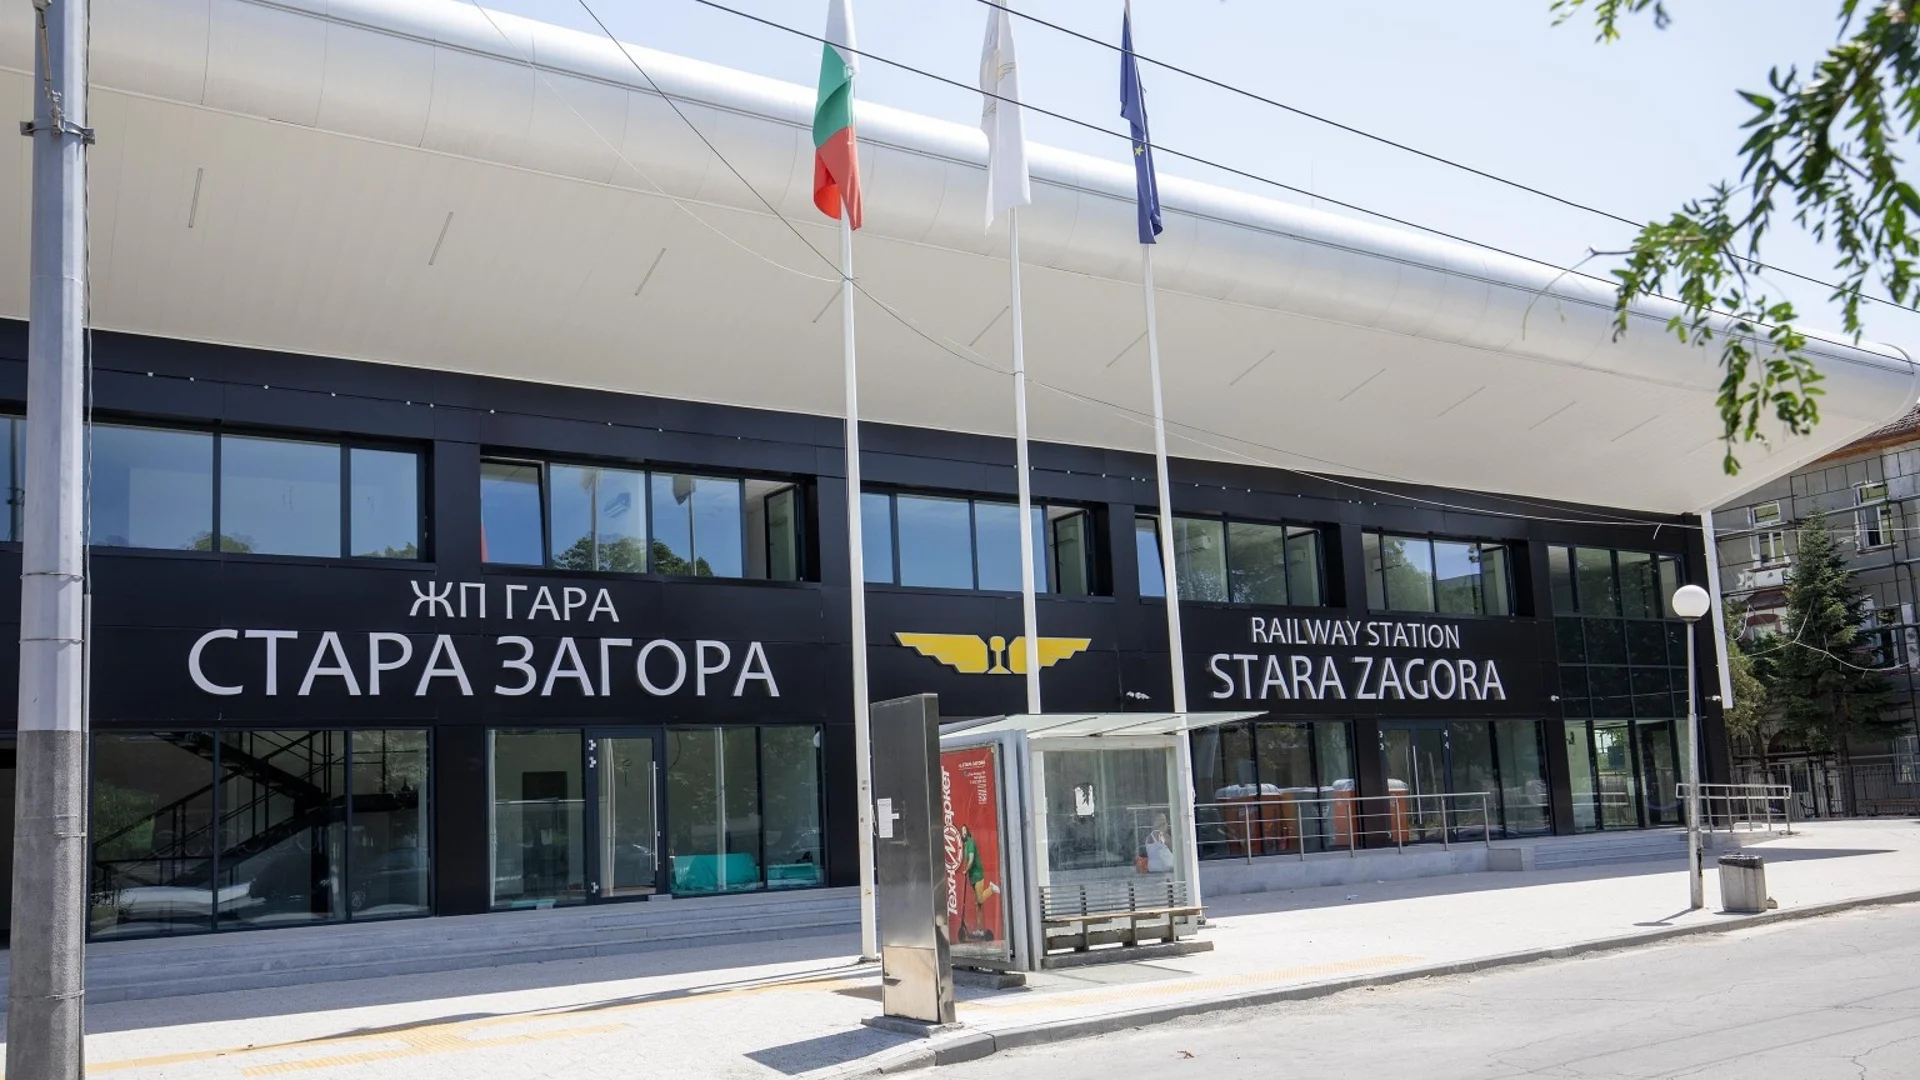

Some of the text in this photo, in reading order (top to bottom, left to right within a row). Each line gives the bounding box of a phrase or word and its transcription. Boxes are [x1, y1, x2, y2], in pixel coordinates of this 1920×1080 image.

[409, 580, 620, 623] ЖП ГАРА
[1251, 616, 1461, 650] RAILWAY STATION
[188, 628, 781, 698] СТАРА ЗАГОРА
[1210, 653, 1507, 701] STARA ZAGORA
